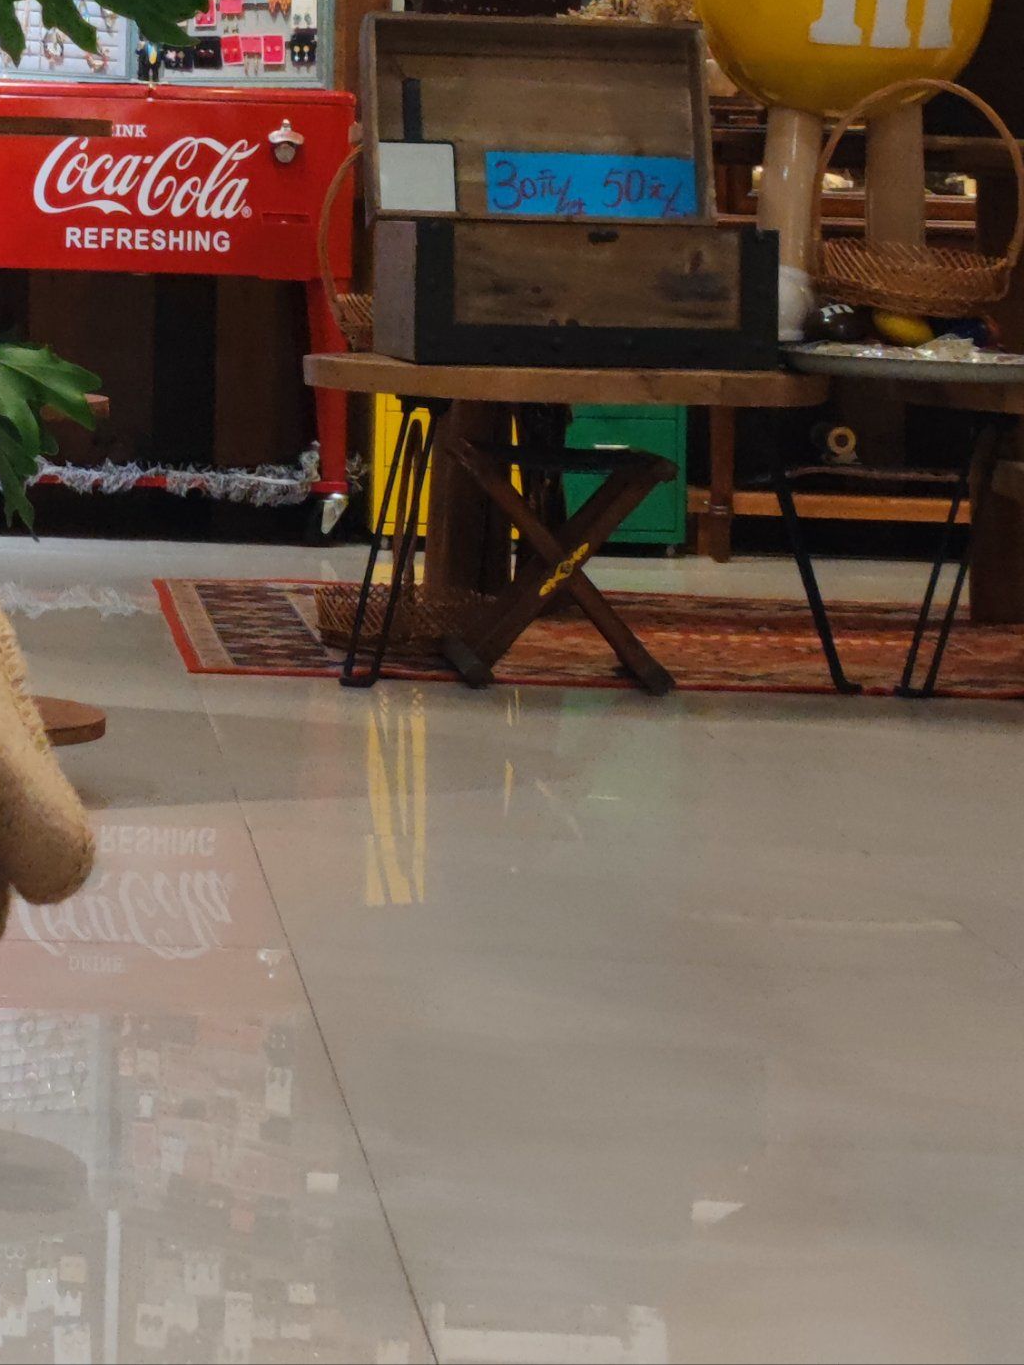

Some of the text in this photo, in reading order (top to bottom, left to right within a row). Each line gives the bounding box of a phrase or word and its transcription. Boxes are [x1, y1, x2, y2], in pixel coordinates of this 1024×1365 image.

[112, 124, 147, 138] INK
[33, 136, 260, 219] Coca-Cola
[65, 227, 231, 252] REFRESHING
